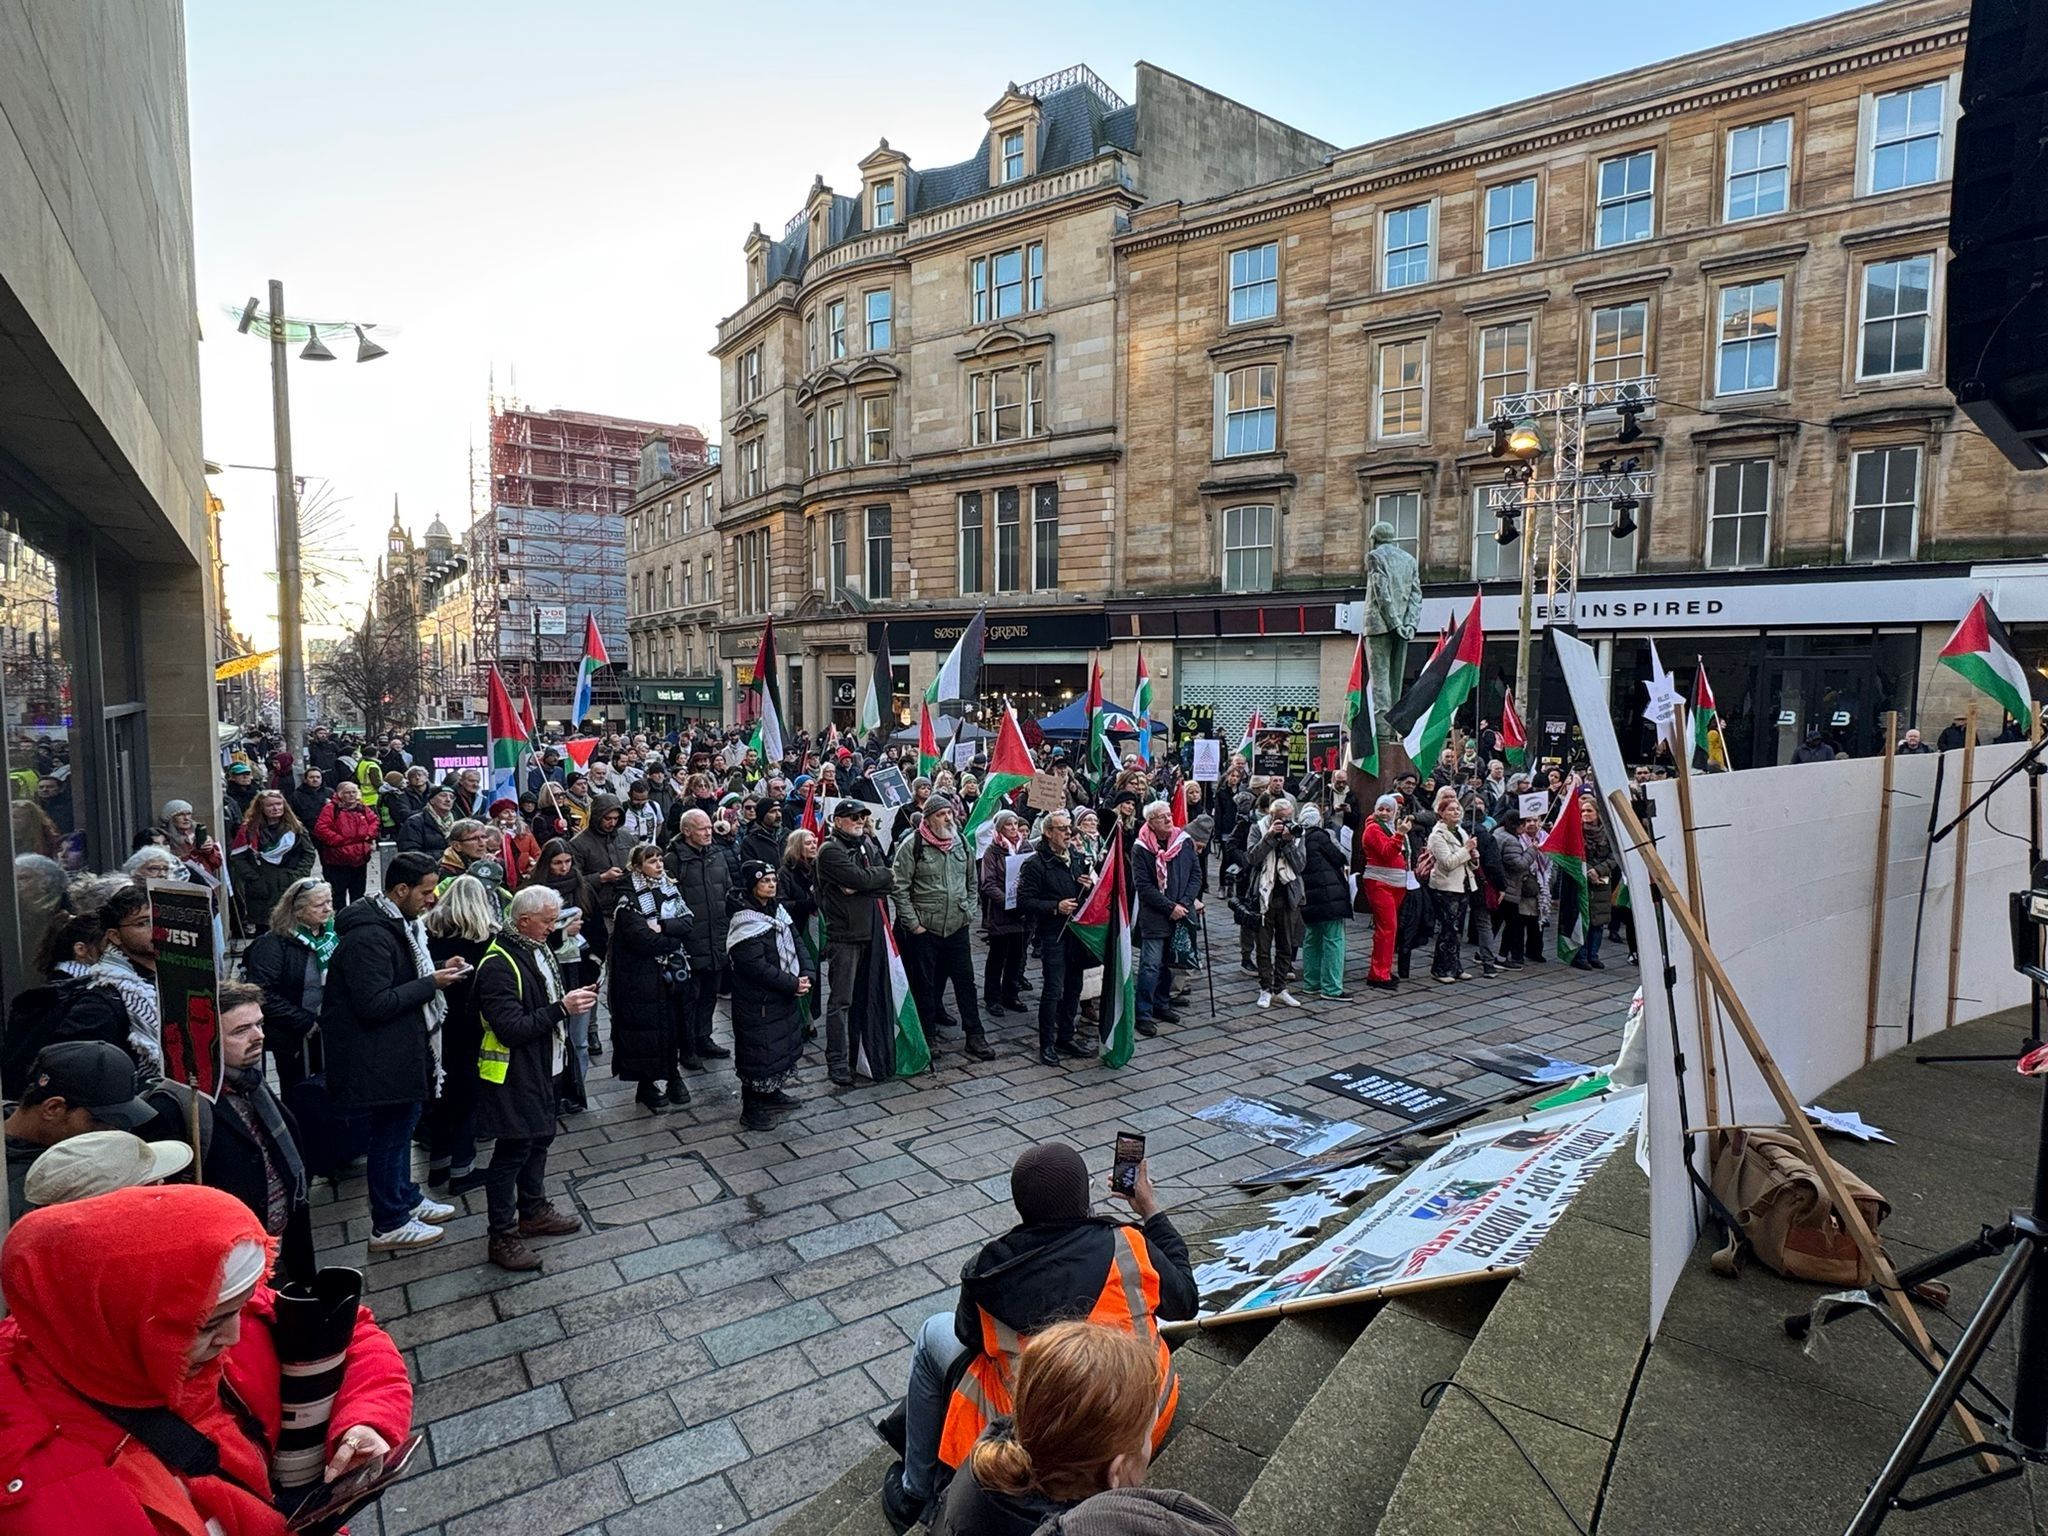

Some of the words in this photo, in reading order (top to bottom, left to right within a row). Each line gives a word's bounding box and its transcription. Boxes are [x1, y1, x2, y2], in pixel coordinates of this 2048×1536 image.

[1518, 606, 1567, 619] EE
[1581, 600, 1723, 618] INSPIRED
[990, 625, 1029, 641] GRENE
[433, 756, 481, 768] TRAVELLING
[1549, 1128, 1615, 1162] TORTURE
[1513, 1167, 1568, 1201] RAPE
[1454, 1205, 1533, 1258] MURDER
